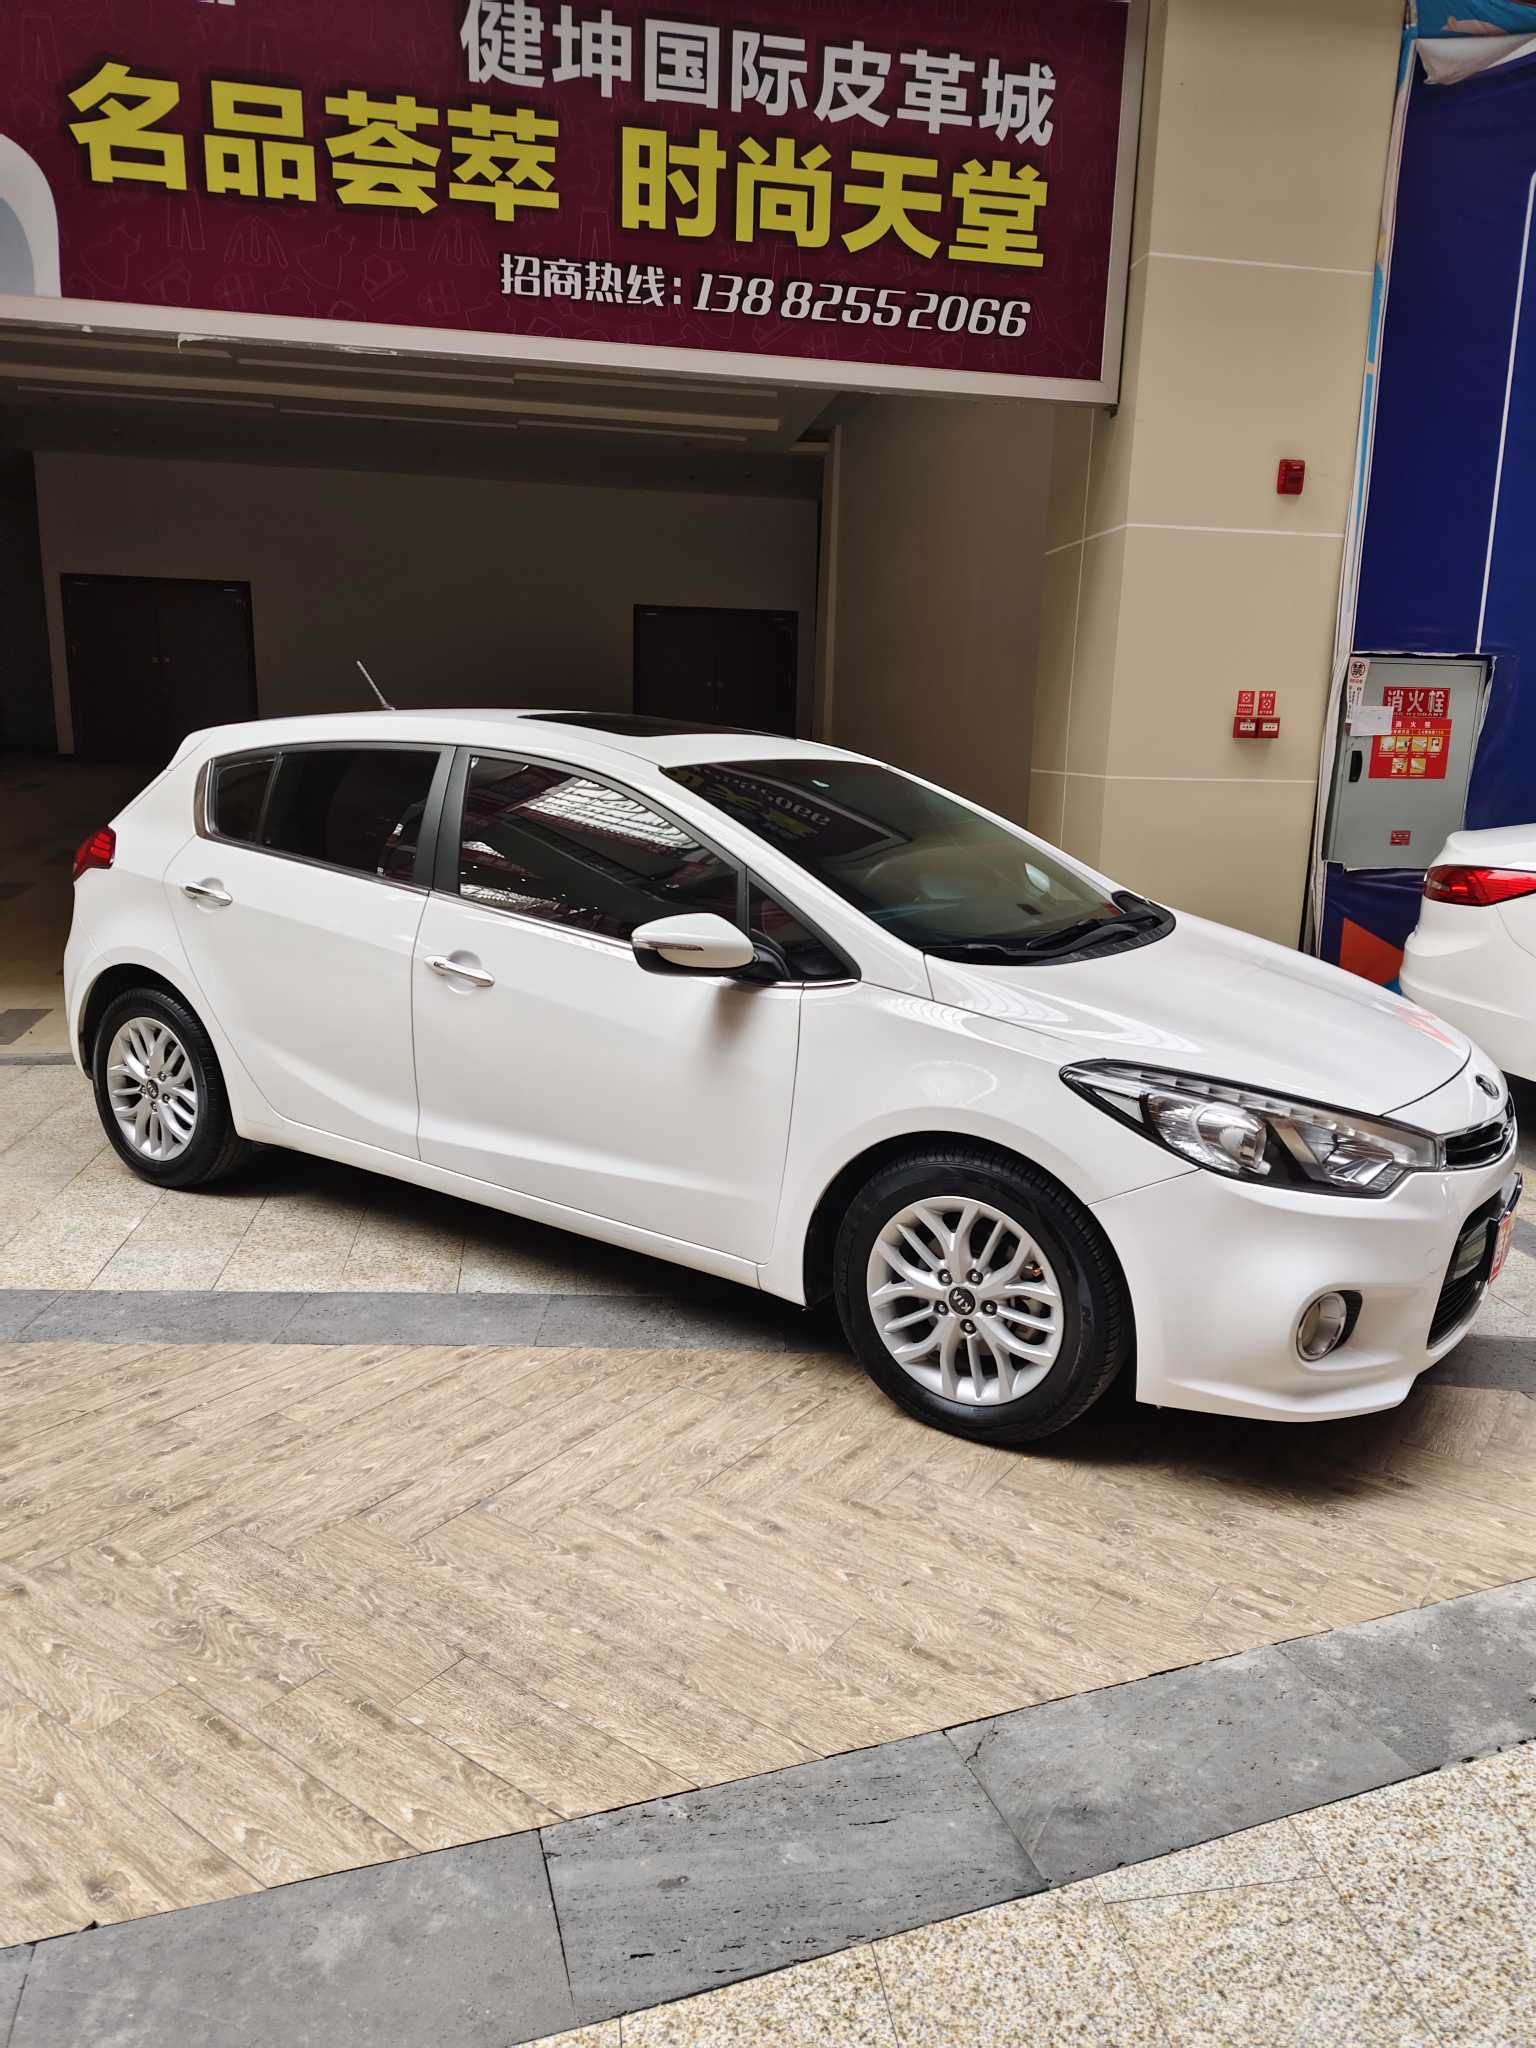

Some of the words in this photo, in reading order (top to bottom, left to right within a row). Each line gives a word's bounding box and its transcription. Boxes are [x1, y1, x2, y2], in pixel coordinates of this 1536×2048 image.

[460, 0, 1056, 145] 健坤国际皮革城
[68, 62, 560, 222] 名品荟萃
[621, 127, 1048, 268] 时尚天堂
[1387, 690, 1445, 713] 消火栓
